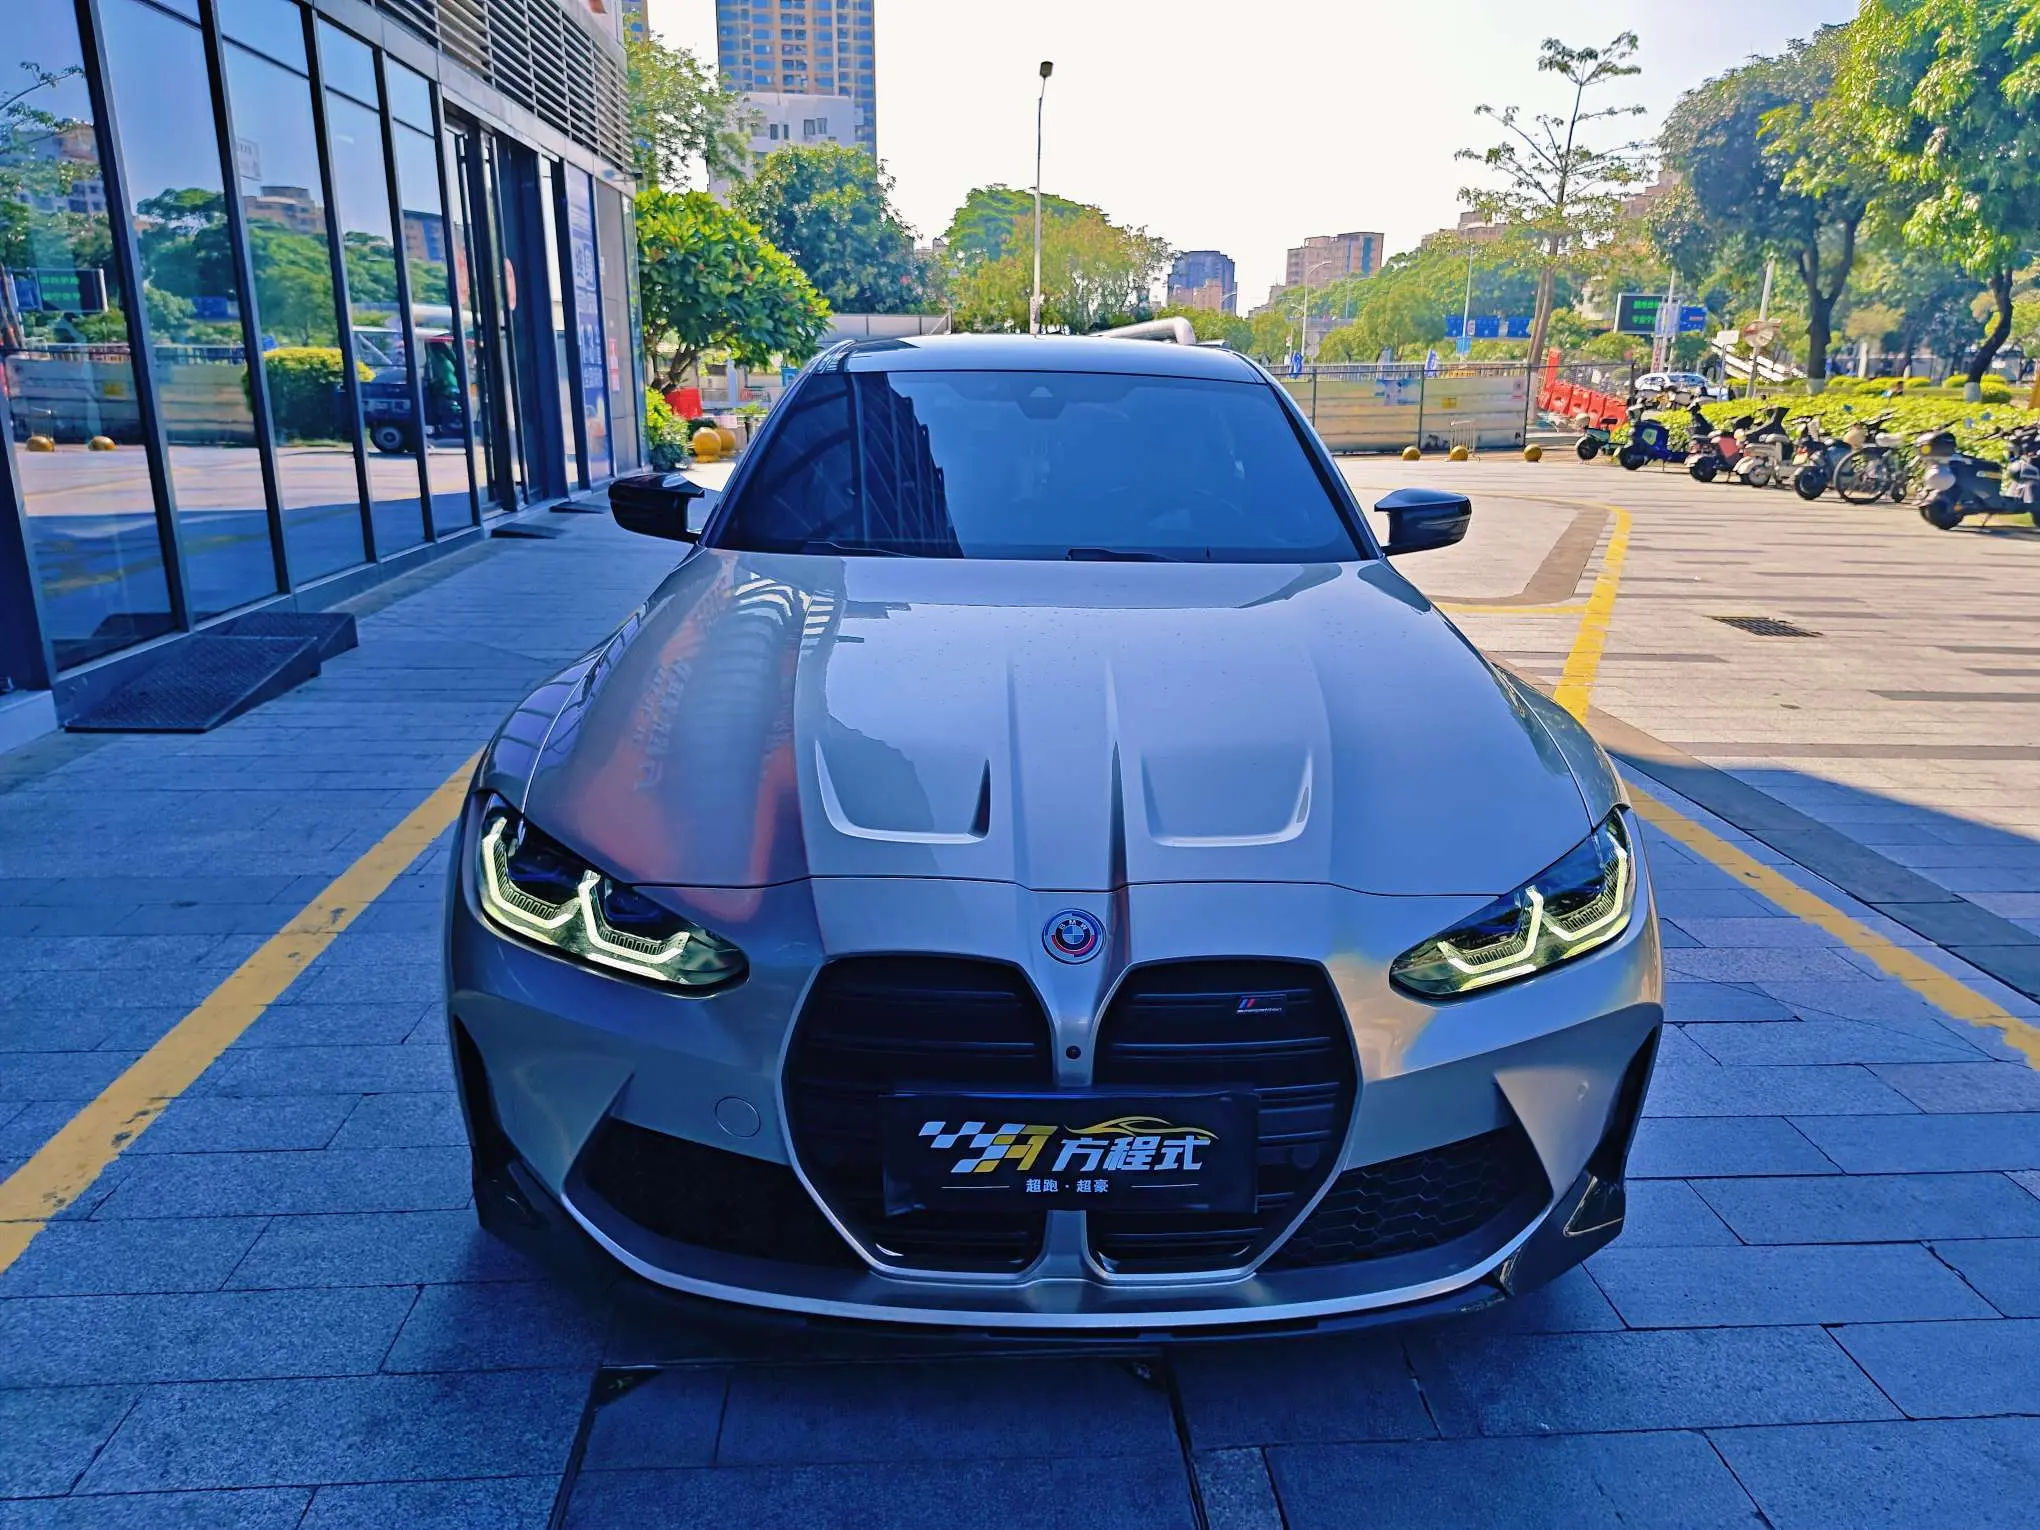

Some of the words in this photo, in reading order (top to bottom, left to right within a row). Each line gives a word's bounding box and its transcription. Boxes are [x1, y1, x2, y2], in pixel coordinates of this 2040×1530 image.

[1059, 919, 1088, 930] BMW
[1052, 1135, 1211, 1171] 方程式
